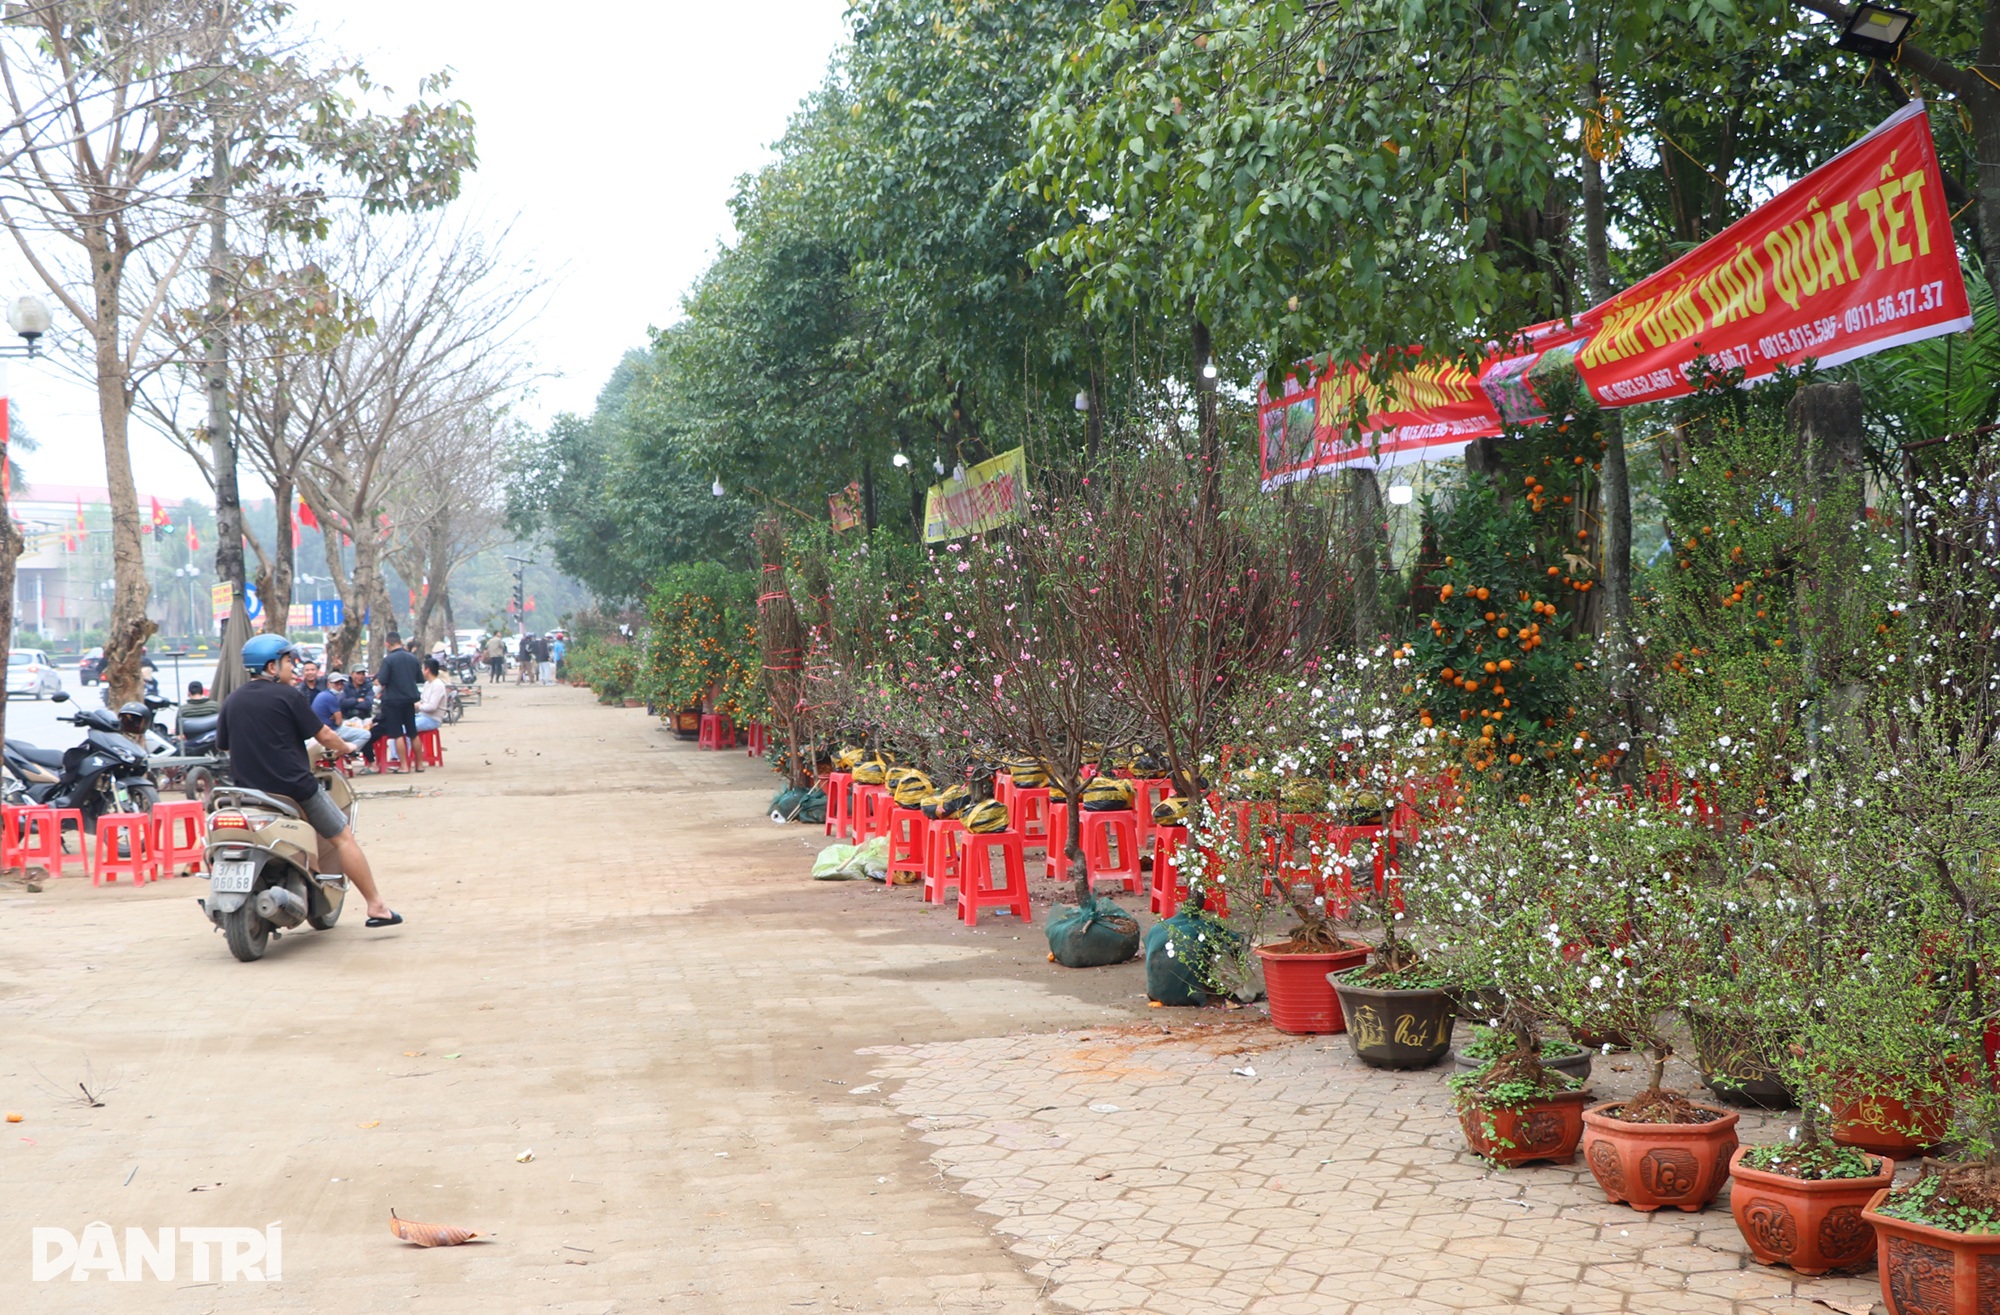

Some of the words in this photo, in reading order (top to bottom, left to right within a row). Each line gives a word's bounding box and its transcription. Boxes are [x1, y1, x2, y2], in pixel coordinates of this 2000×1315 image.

[1764, 183, 1861, 311] QUẤT
[1858, 149, 1930, 271] TẾT
[1845, 280, 1943, 333] 0911.56.37.37
